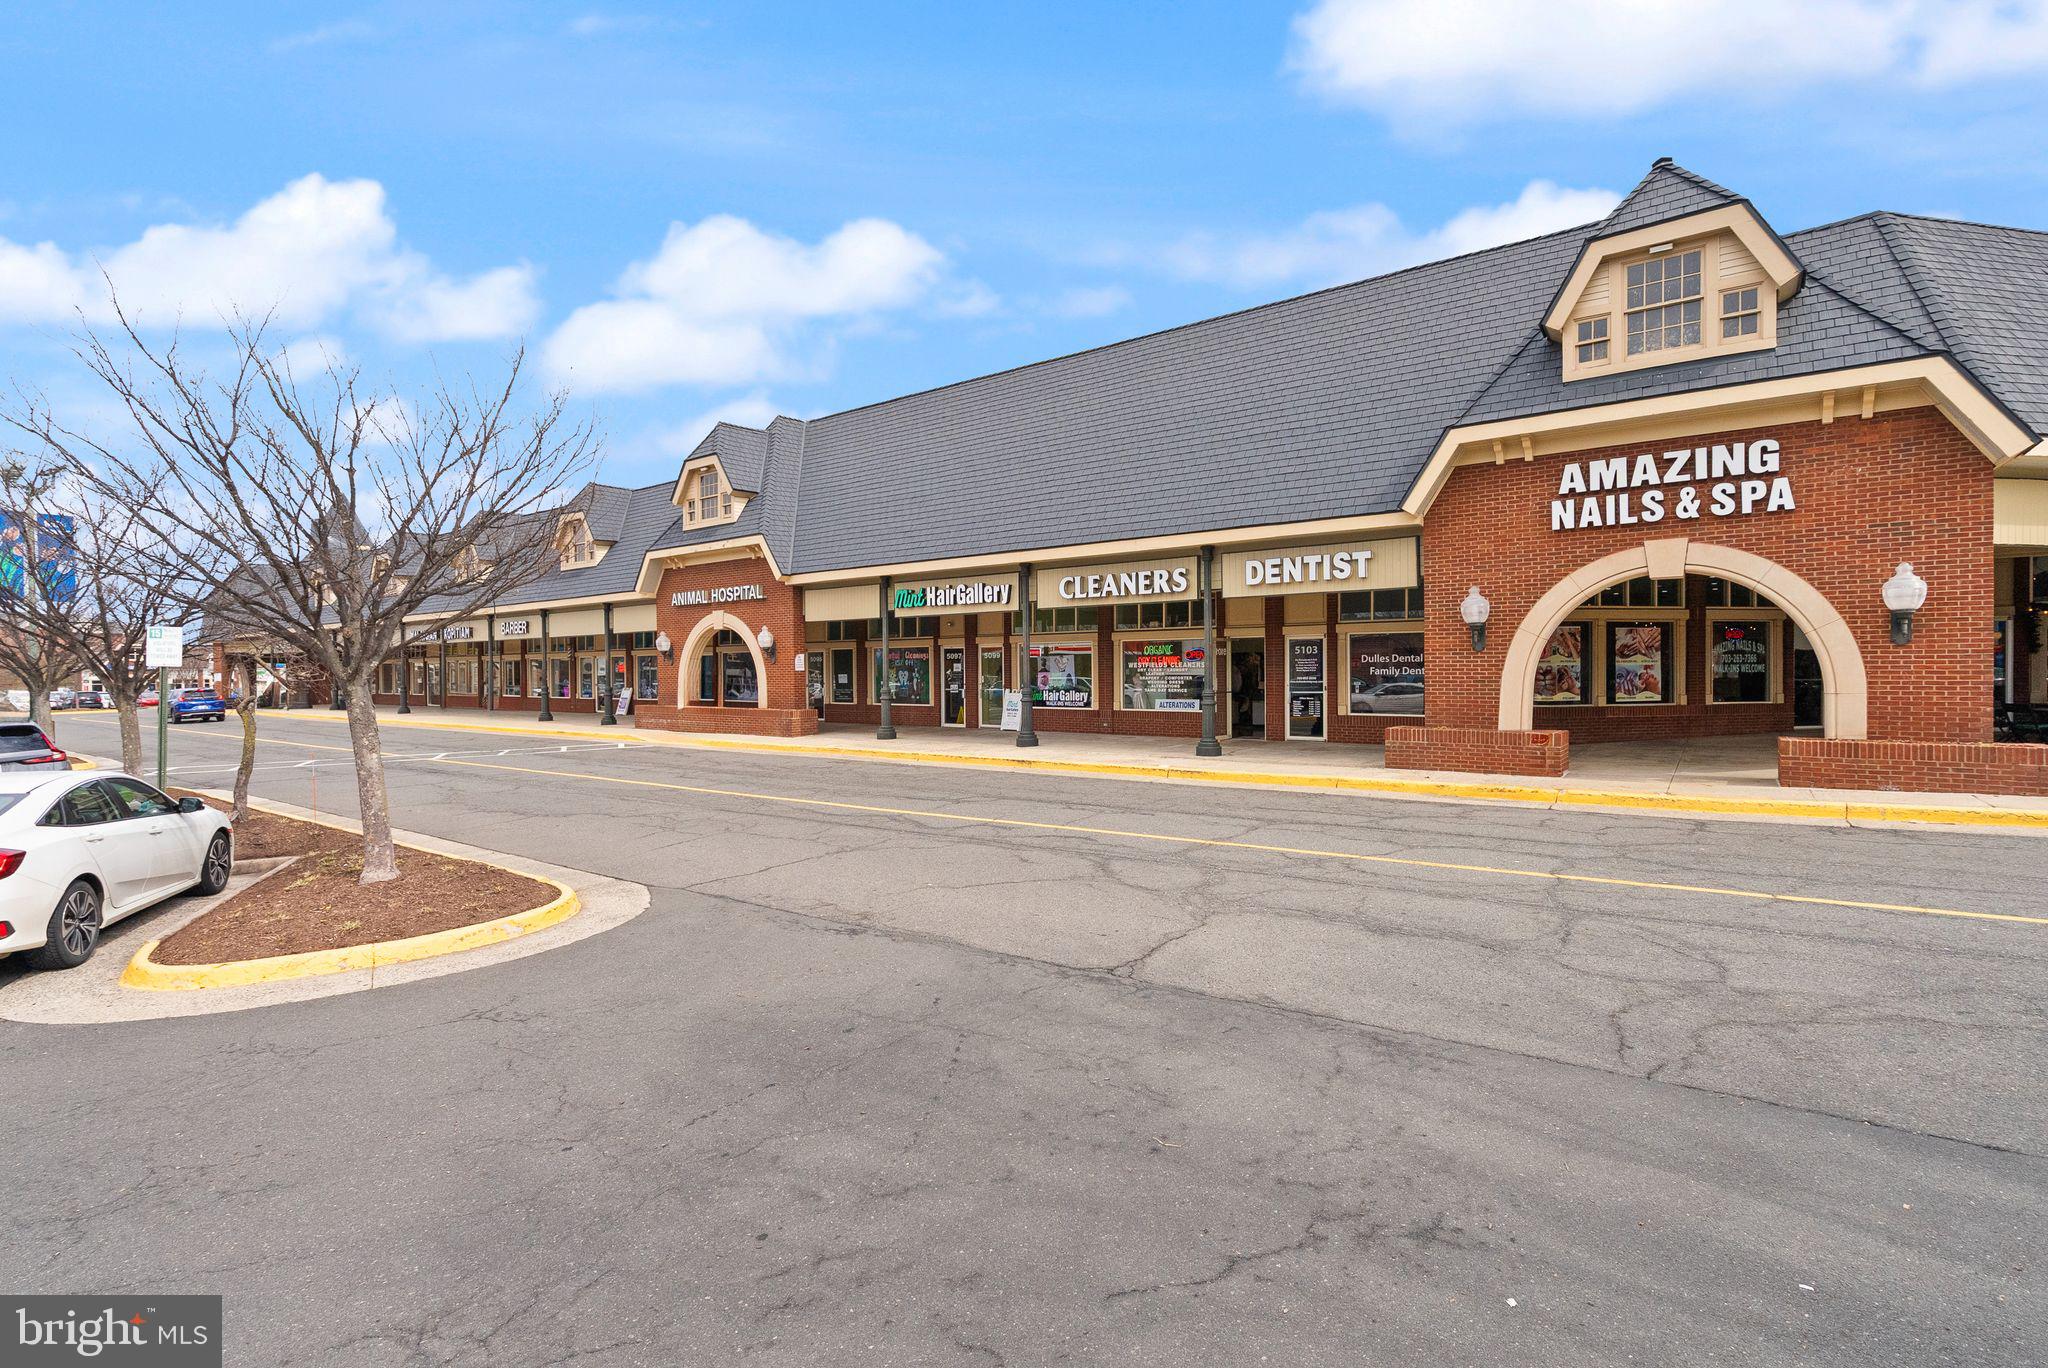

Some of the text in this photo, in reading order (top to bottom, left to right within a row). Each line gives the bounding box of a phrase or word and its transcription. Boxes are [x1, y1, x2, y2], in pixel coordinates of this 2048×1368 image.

[1558, 439, 1780, 495] AMAZING
[1551, 477, 1796, 530] NAILS & SPA
[1245, 550, 1372, 586] DENTIST
[1059, 567, 1188, 599] CLEANERS
[671, 584, 763, 606] ANIMAL HOSPITAL
[894, 588, 926, 608] Mint
[500, 620, 527, 635] BARBER
[1143, 644, 1174, 656] ORGANIC
[1185, 650, 1205, 660] OPEN
[1294, 645, 1318, 654] 5103
[1361, 653, 1423, 663] Dulles Dental
[1370, 666, 1400, 677] Family
[1740, 663, 1766, 672] WELCOME
[1159, 701, 1196, 709] ALTERATIONS
